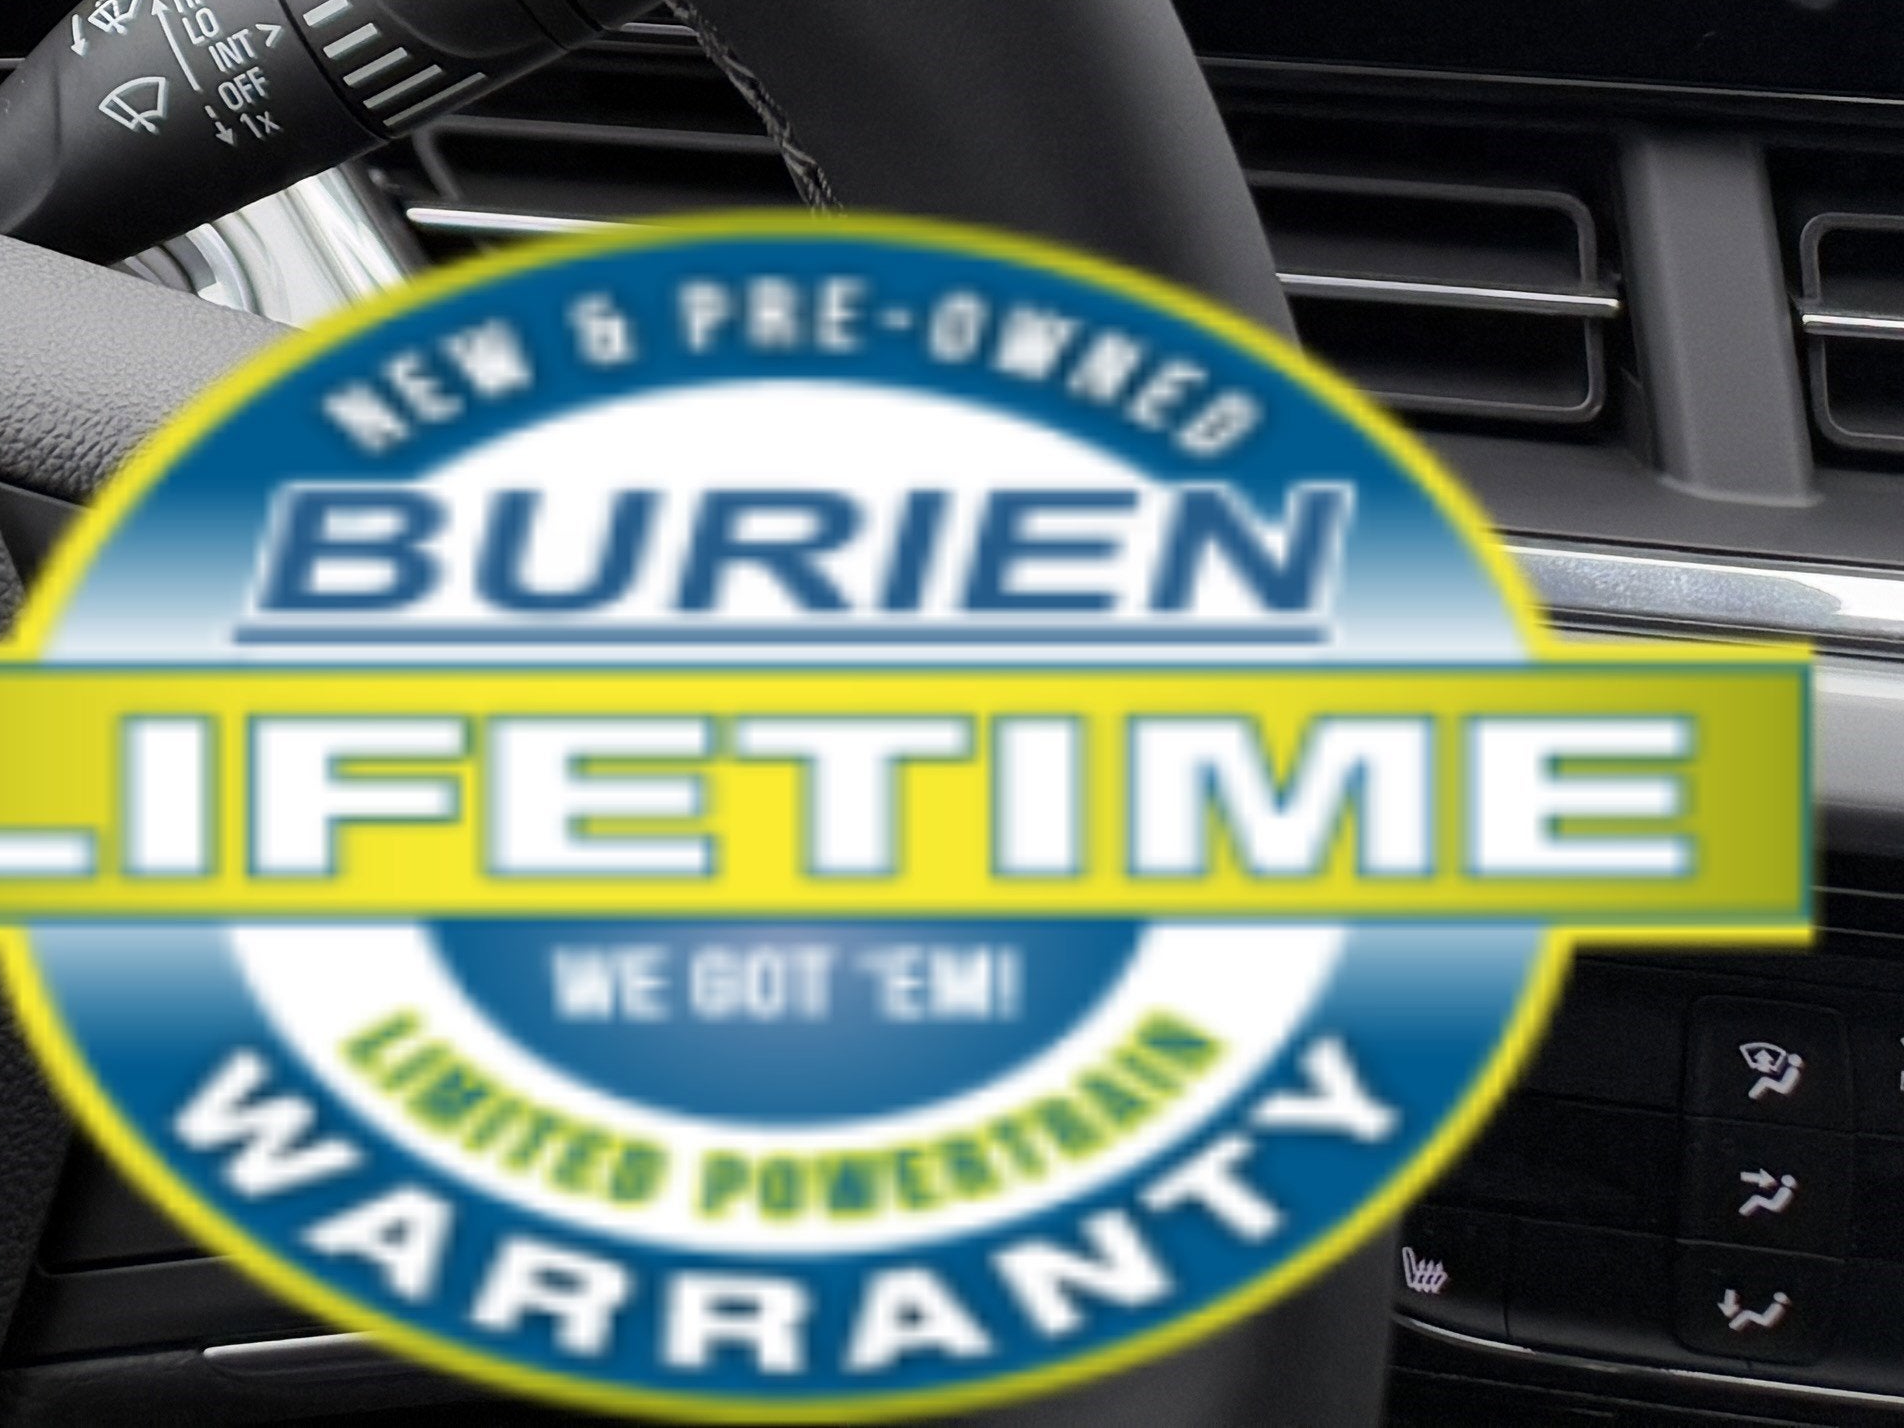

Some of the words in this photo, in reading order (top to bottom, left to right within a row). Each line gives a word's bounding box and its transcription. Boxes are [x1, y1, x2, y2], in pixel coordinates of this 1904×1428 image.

[182, 7, 220, 44] LO
[208, 28, 256, 73] INT
[217, 66, 267, 111] OFF
[240, 111, 281, 139] 1x
